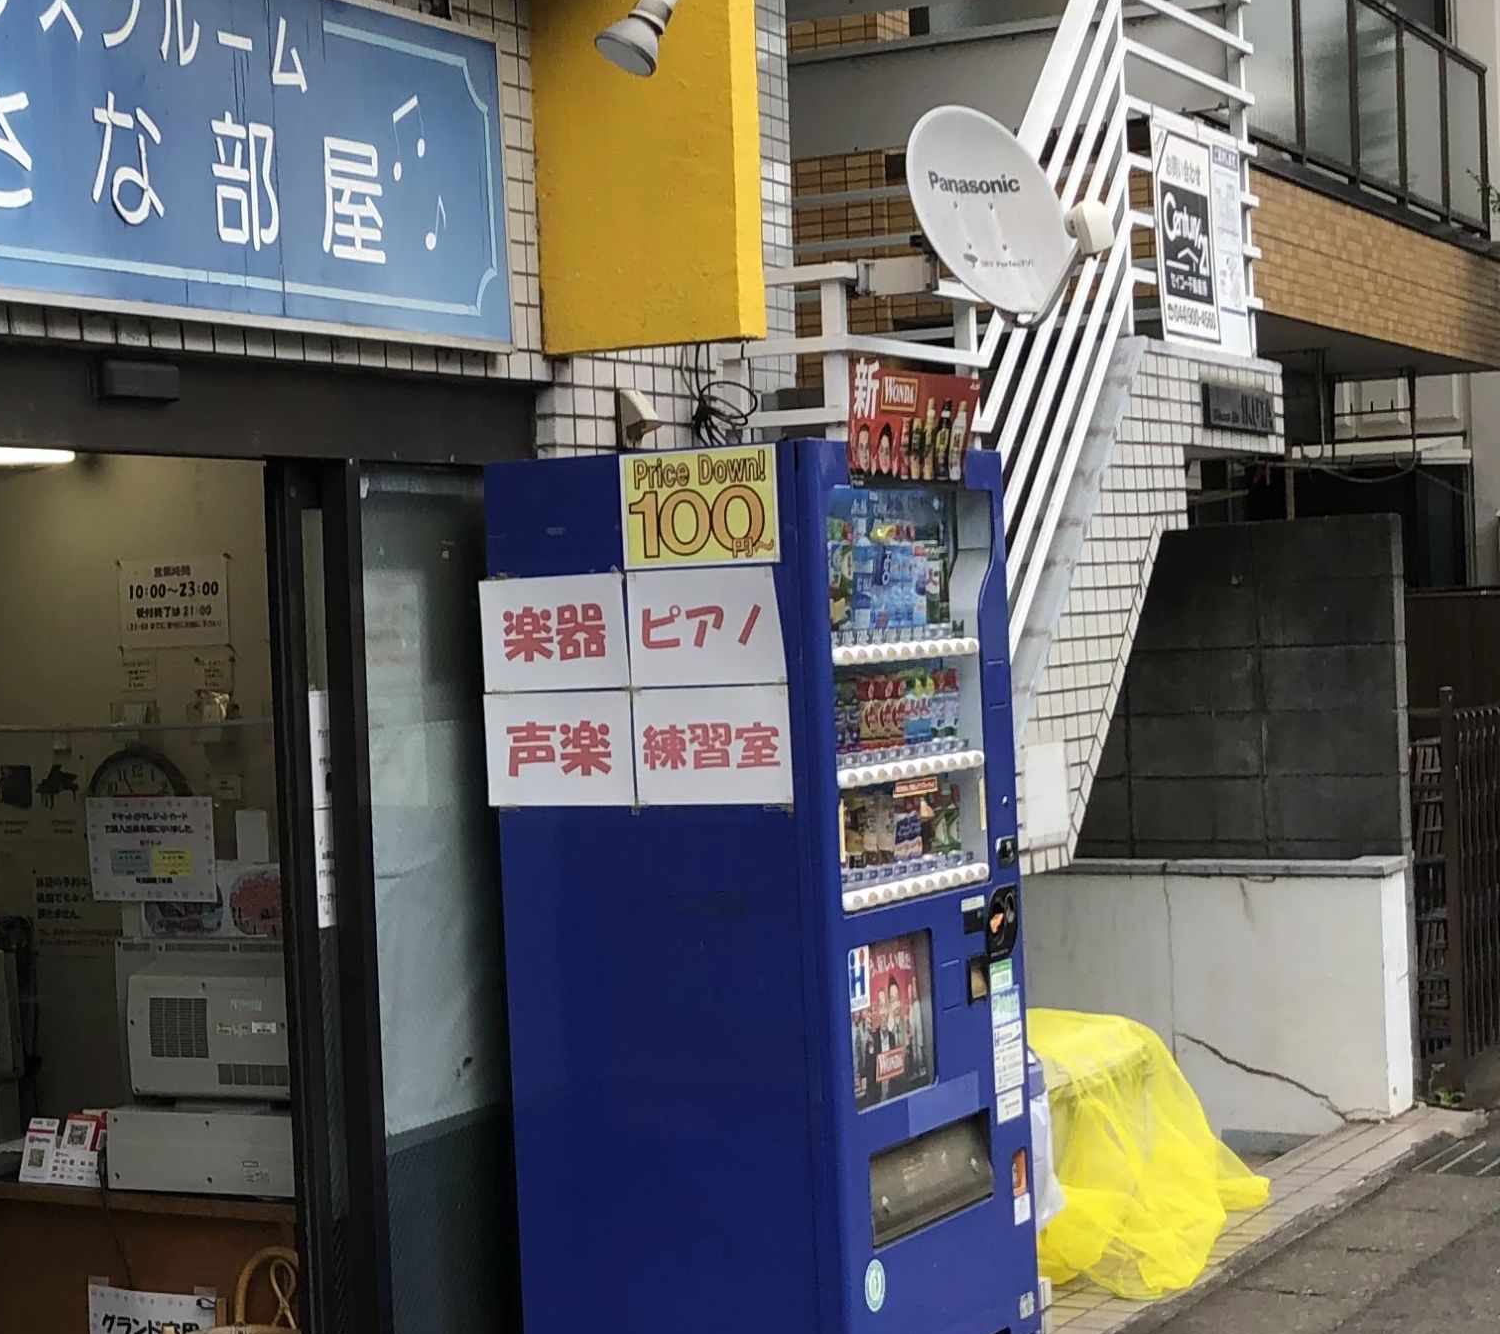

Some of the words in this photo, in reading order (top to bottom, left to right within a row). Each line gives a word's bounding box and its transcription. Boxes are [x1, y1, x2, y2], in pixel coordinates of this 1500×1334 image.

[928, 171, 1021, 195] Panasonic
[853, 357, 880, 420] 新
[633, 457, 690, 490] Price
[697, 449, 766, 486] Down!
[502, 603, 606, 662] 楽器
[641, 604, 762, 650] ピアノ
[506, 720, 612, 777] 声楽
[642, 721, 781, 771] 練習室
